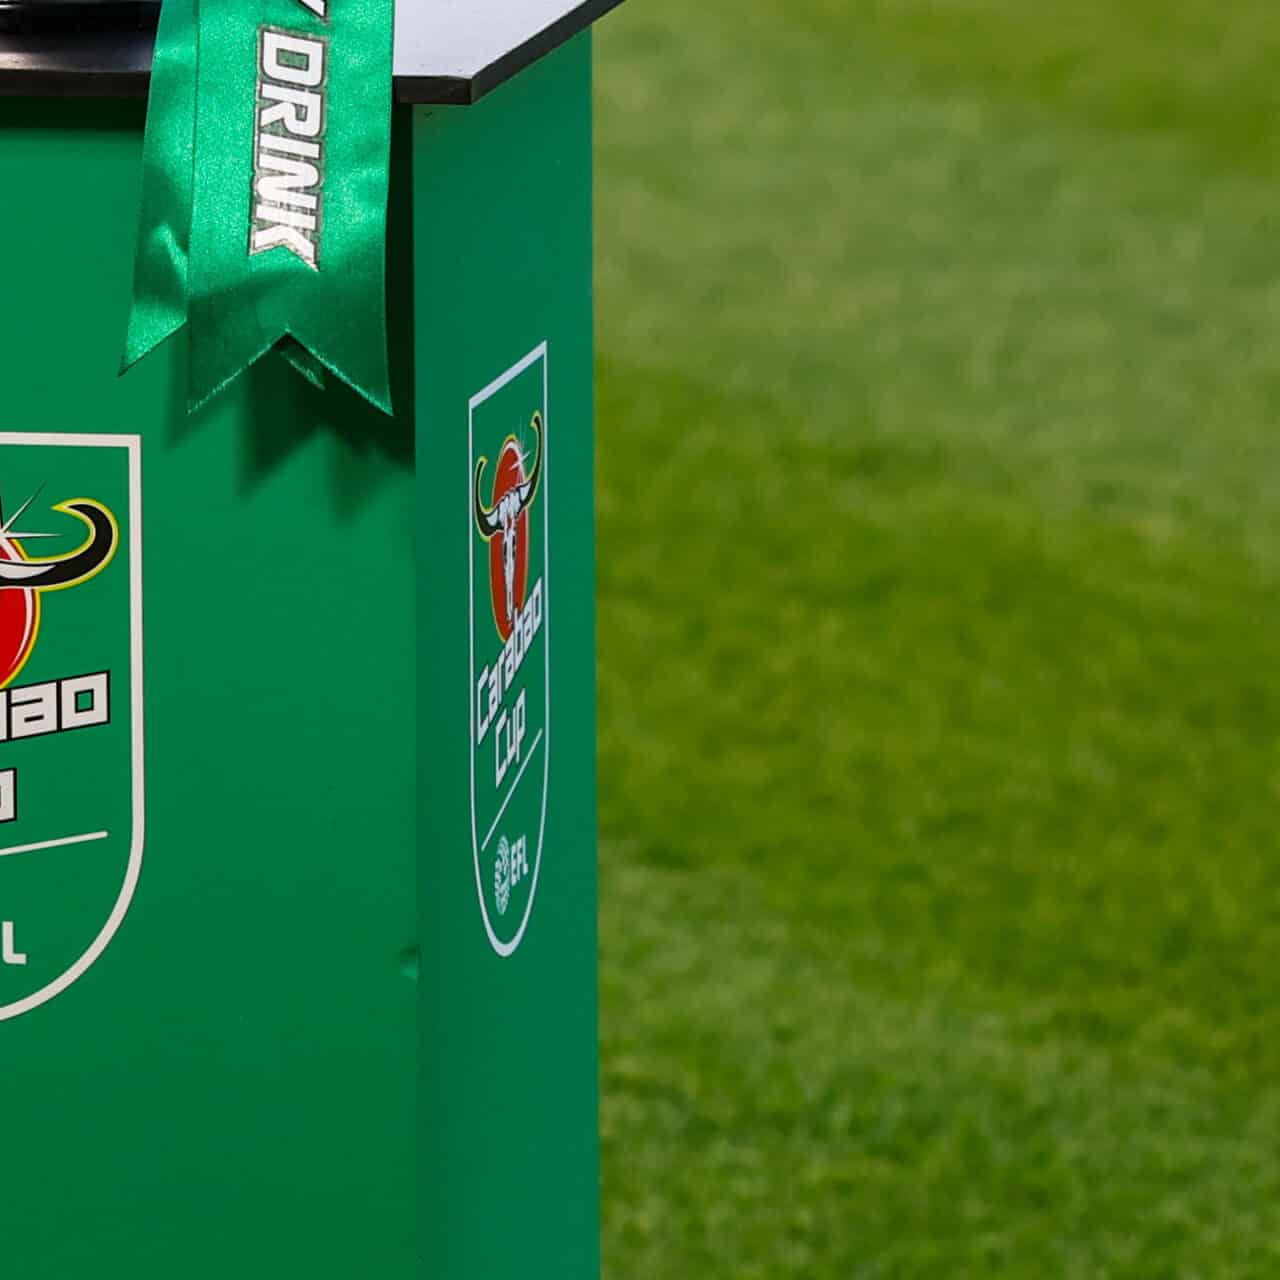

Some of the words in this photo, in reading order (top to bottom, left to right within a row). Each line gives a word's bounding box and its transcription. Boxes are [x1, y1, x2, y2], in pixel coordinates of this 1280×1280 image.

[249, 28, 327, 271] DRINK
[477, 576, 543, 747] Carabao
[495, 687, 526, 789] Cup
[510, 833, 529, 887] EFL
